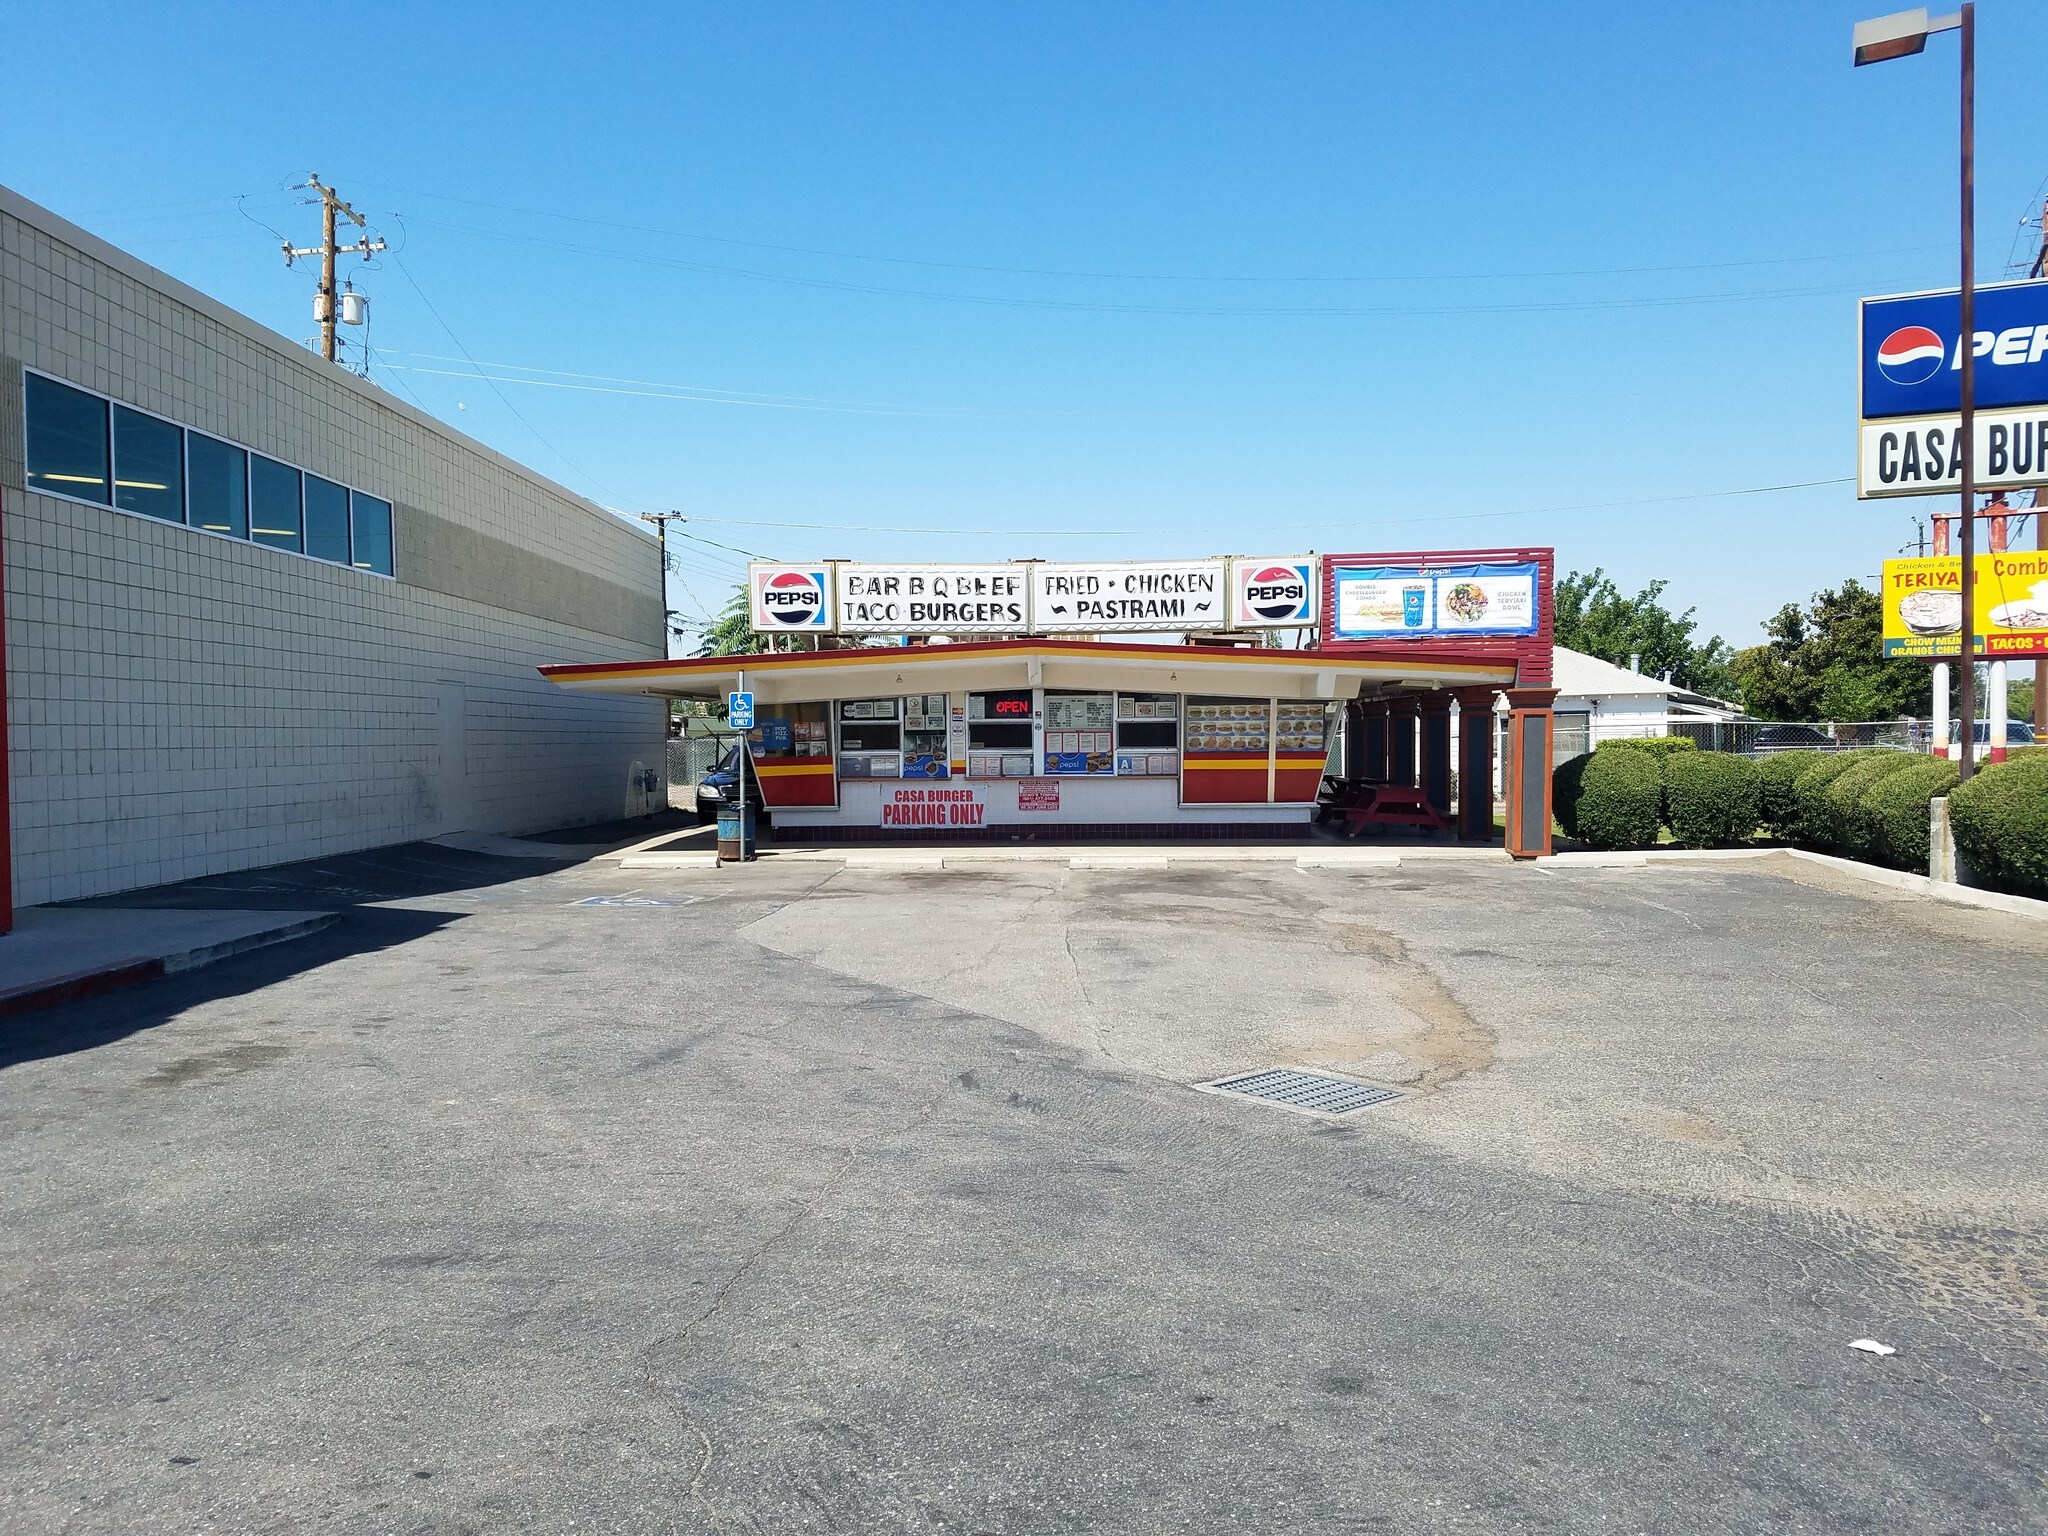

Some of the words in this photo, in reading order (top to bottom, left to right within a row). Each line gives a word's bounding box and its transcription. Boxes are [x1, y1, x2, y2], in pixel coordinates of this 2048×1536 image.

[1045, 575, 1100, 596] FRIED
[1124, 573, 1214, 594] CHICKEN
[1892, 570, 1979, 588] TERIYAI
[849, 576, 901, 596] BAR
[908, 577, 925, 596] B
[934, 577, 949, 598] Q
[956, 576, 1021, 596] BEEF
[1247, 585, 1303, 600] PEPSI
[764, 591, 819, 606] PEPSI
[843, 602, 900, 622] TACO
[910, 602, 1023, 622] BURGERS
[1077, 598, 1185, 619] PASTRAMI
[1903, 637, 1936, 647] CHOW
[1990, 636, 2034, 650] TACOS
[1890, 646, 1935, 656] ORANGE
[1936, 644, 1983, 654] CHICN
[996, 701, 1029, 713] OPEN
[904, 765, 924, 773] pepsi
[1059, 761, 1079, 769] pepsi
[1120, 759, 1129, 769] A
[894, 790, 925, 803] CASA
[927, 790, 974, 802] BURGER
[883, 803, 946, 825] PARKING
[950, 803, 985, 825] ONLY
